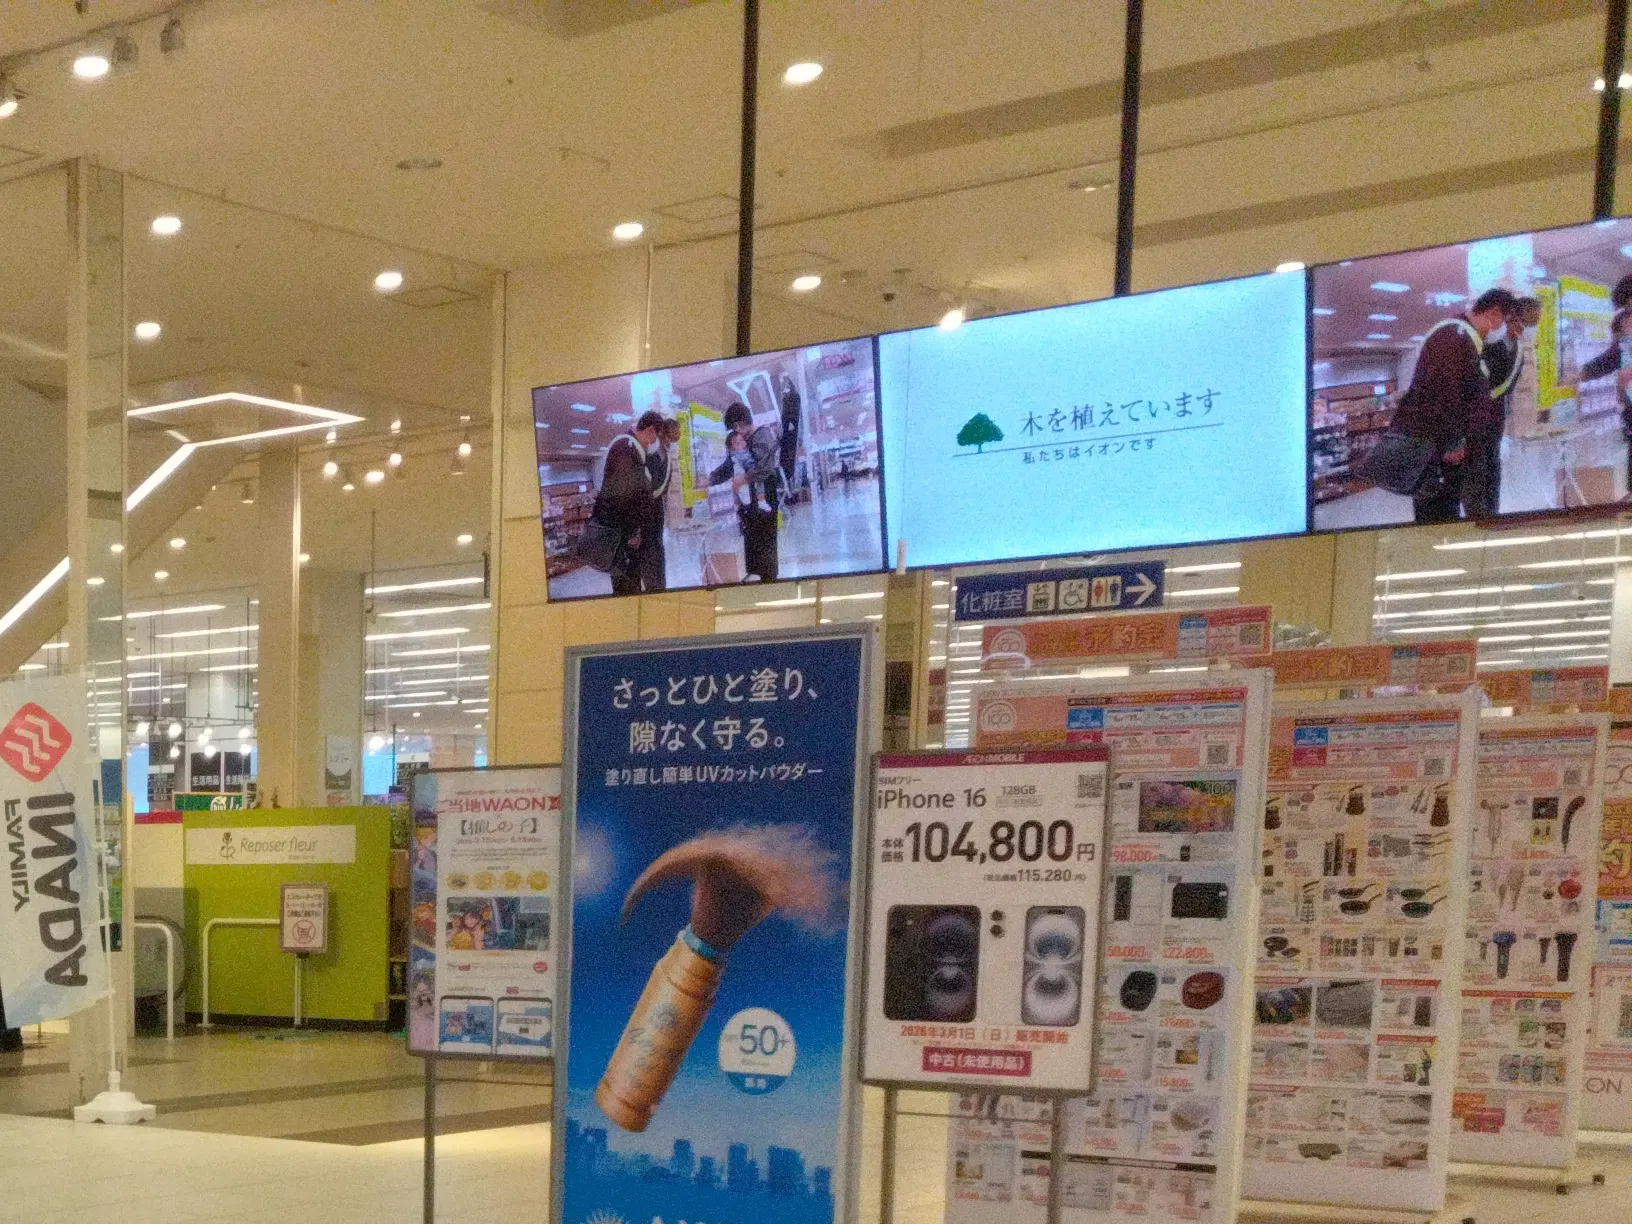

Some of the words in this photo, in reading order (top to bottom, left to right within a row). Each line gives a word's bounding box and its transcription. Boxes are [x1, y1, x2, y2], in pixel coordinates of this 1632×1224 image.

[1020, 387, 1223, 437] 木を植えています
[1022, 437, 1158, 464] 私たちはイオンです
[962, 588, 1025, 615] 化粧室
[612, 667, 817, 710] さっとひと塗り、
[629, 716, 785, 754] 隙なく守る。
[604, 763, 824, 786] 塗り直し簡単UVカットパウダー
[877, 789, 955, 809] iPhone
[963, 787, 987, 807] 16
[1001, 784, 1036, 796] 128GB
[241, 836, 285, 856] Reposer
[289, 834, 318, 852] fleur
[881, 837, 905, 849] 本体
